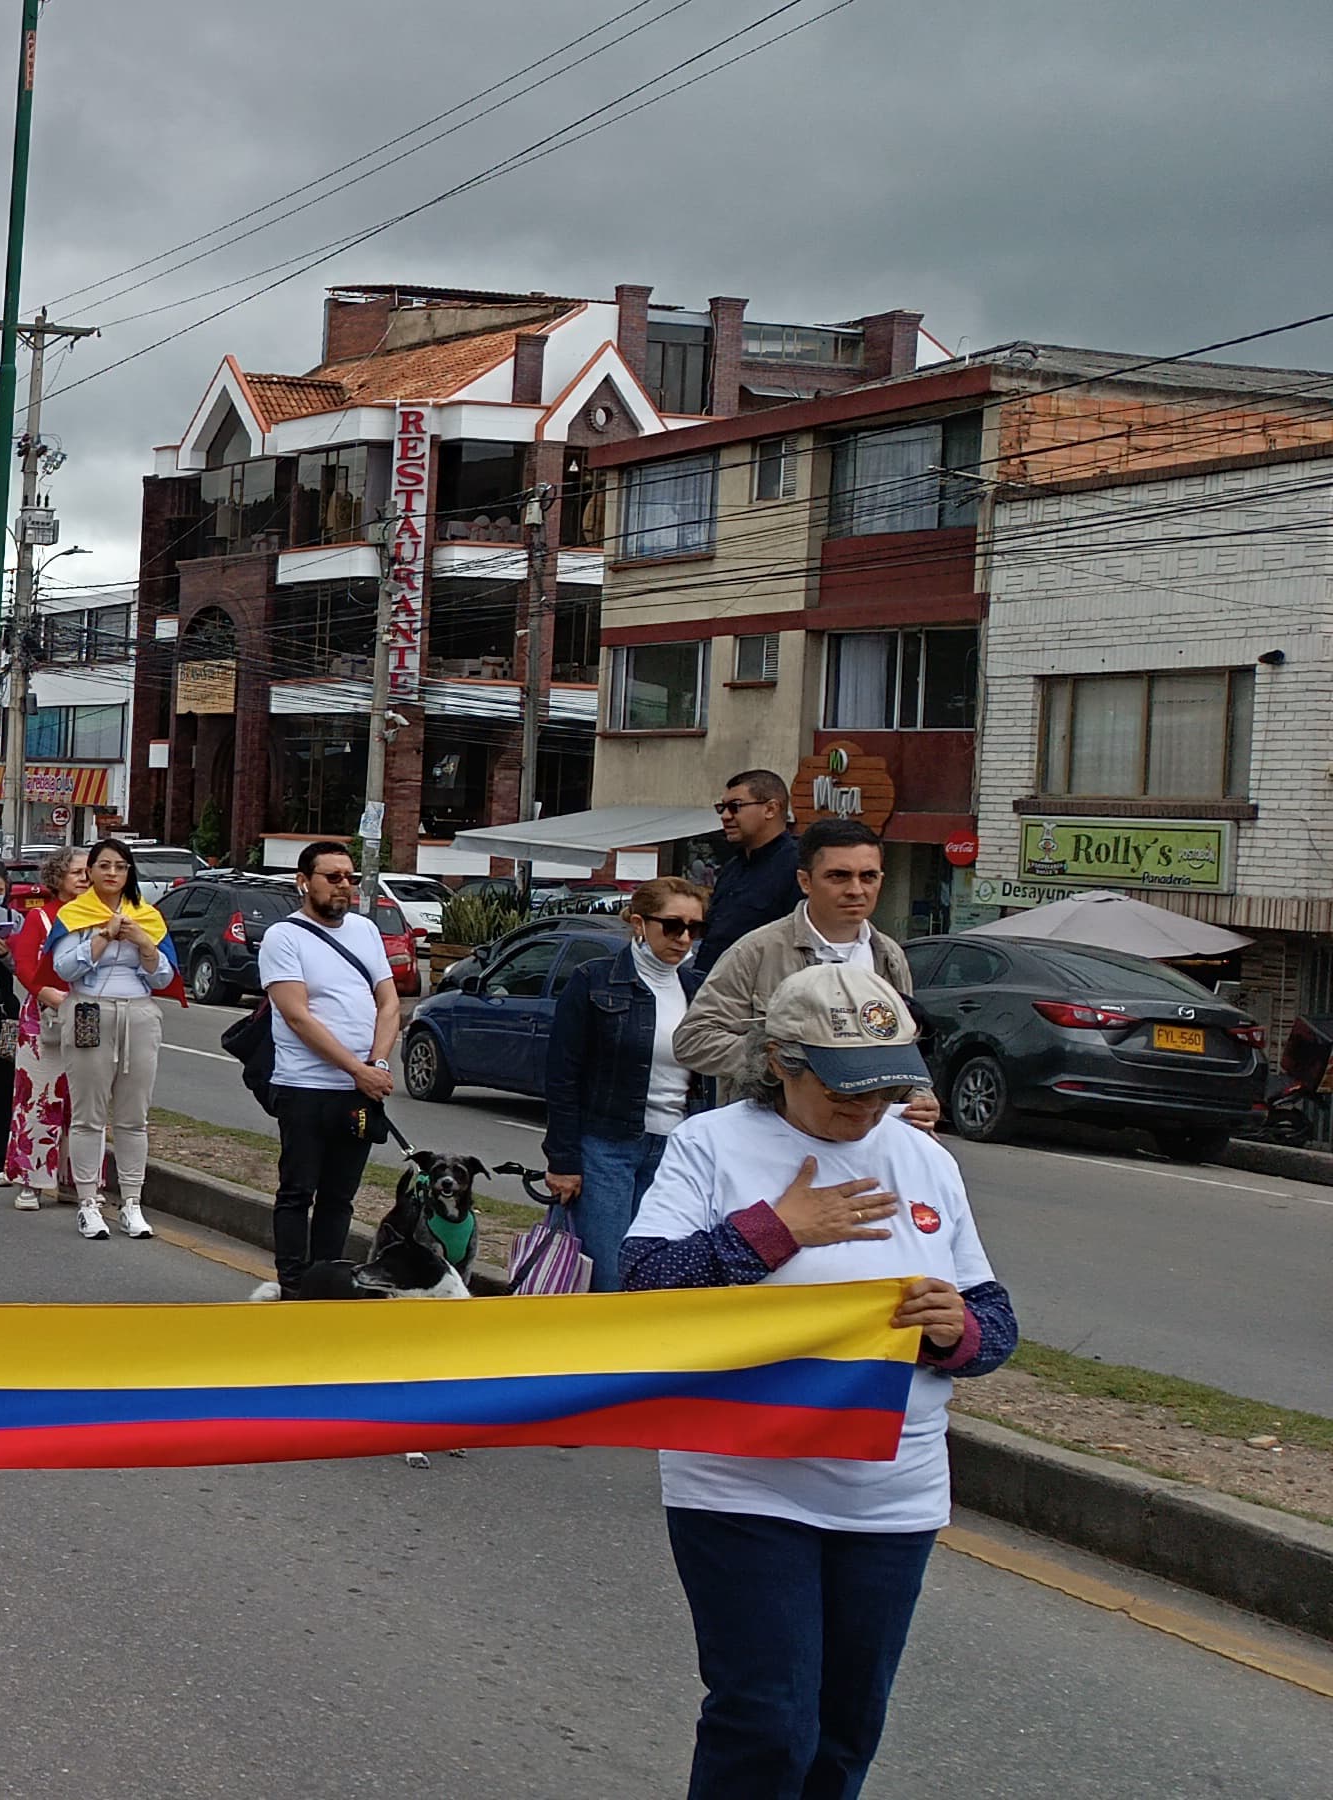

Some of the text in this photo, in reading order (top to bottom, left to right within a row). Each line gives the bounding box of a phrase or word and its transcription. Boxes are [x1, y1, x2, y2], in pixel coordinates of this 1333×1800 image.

[389, 410, 427, 696] RESTAURANTE
[813, 775, 864, 820] Miga
[1157, 1029, 1201, 1046] FYL 560
